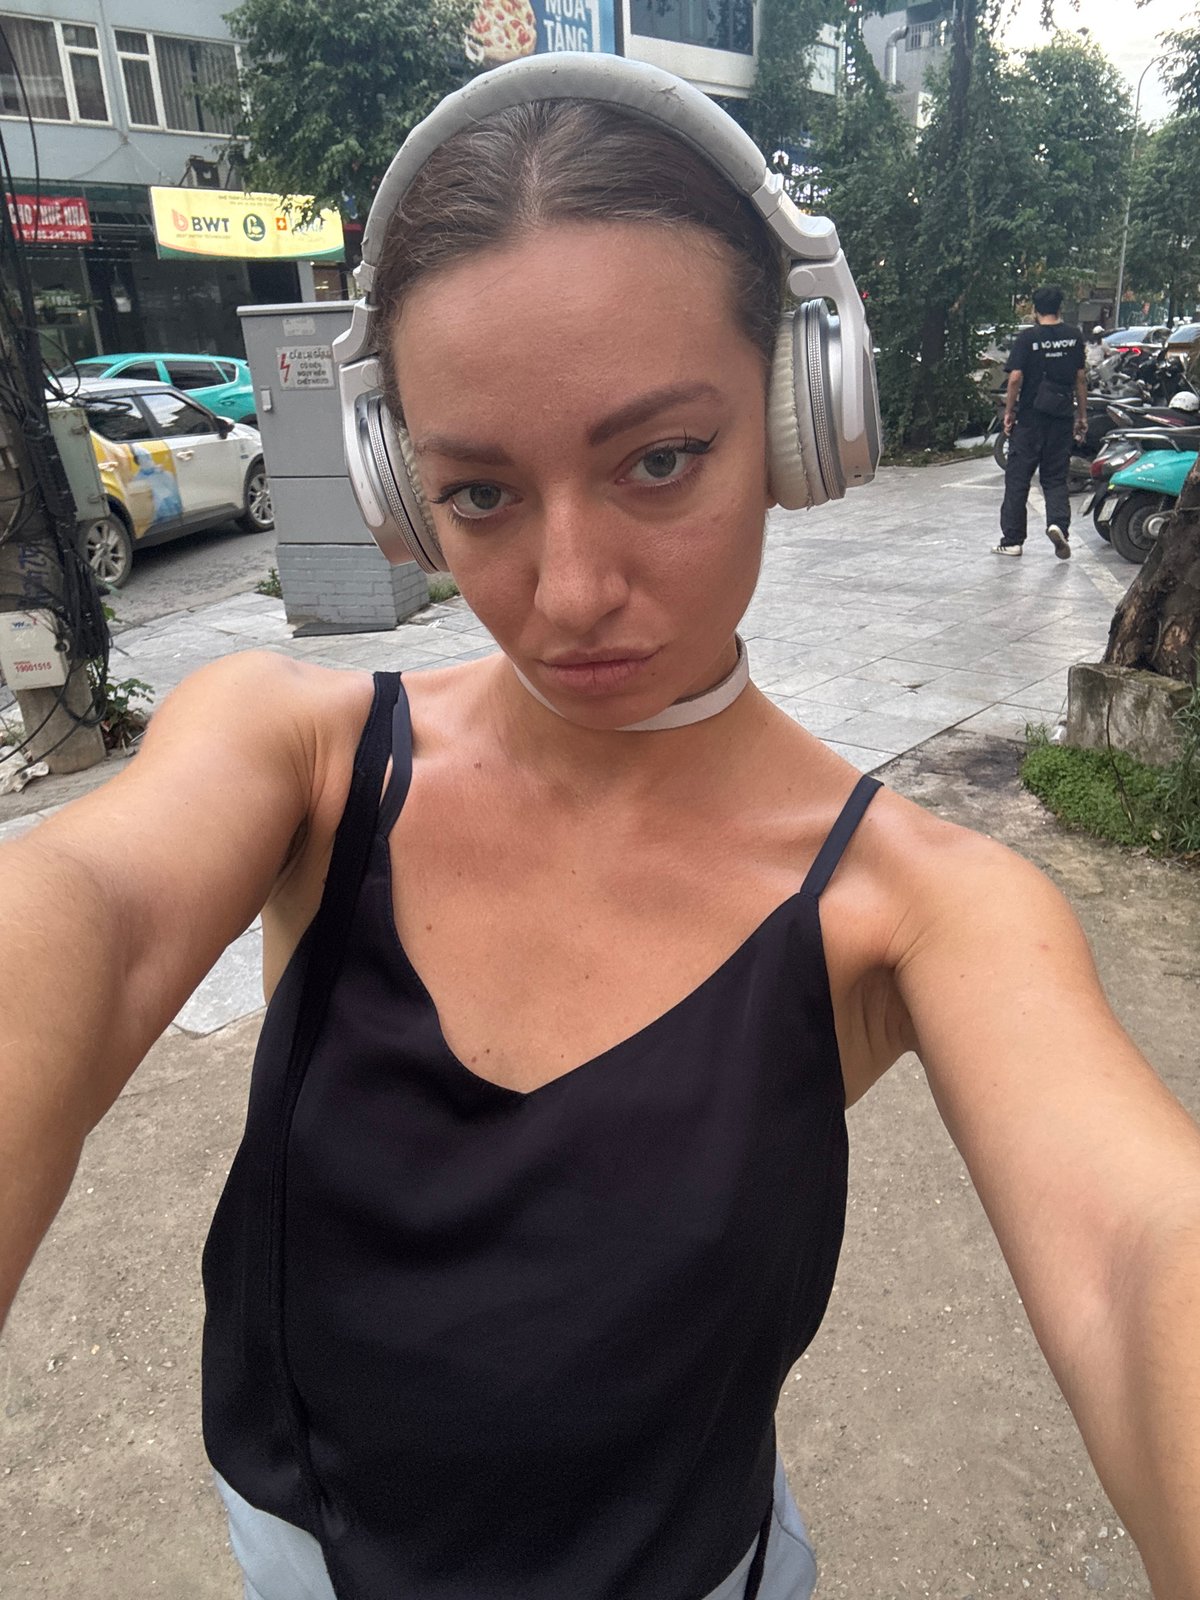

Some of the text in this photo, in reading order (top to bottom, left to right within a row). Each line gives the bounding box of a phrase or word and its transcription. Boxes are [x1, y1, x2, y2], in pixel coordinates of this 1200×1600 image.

[545, 0, 587, 21] MUA
[543, 15, 588, 52] TĂNG
[33, 202, 63, 226] HUÊ
[191, 216, 230, 233] BWT
[1052, 339, 1077, 348] WOW
[15, 662, 52, 672] 19001515
